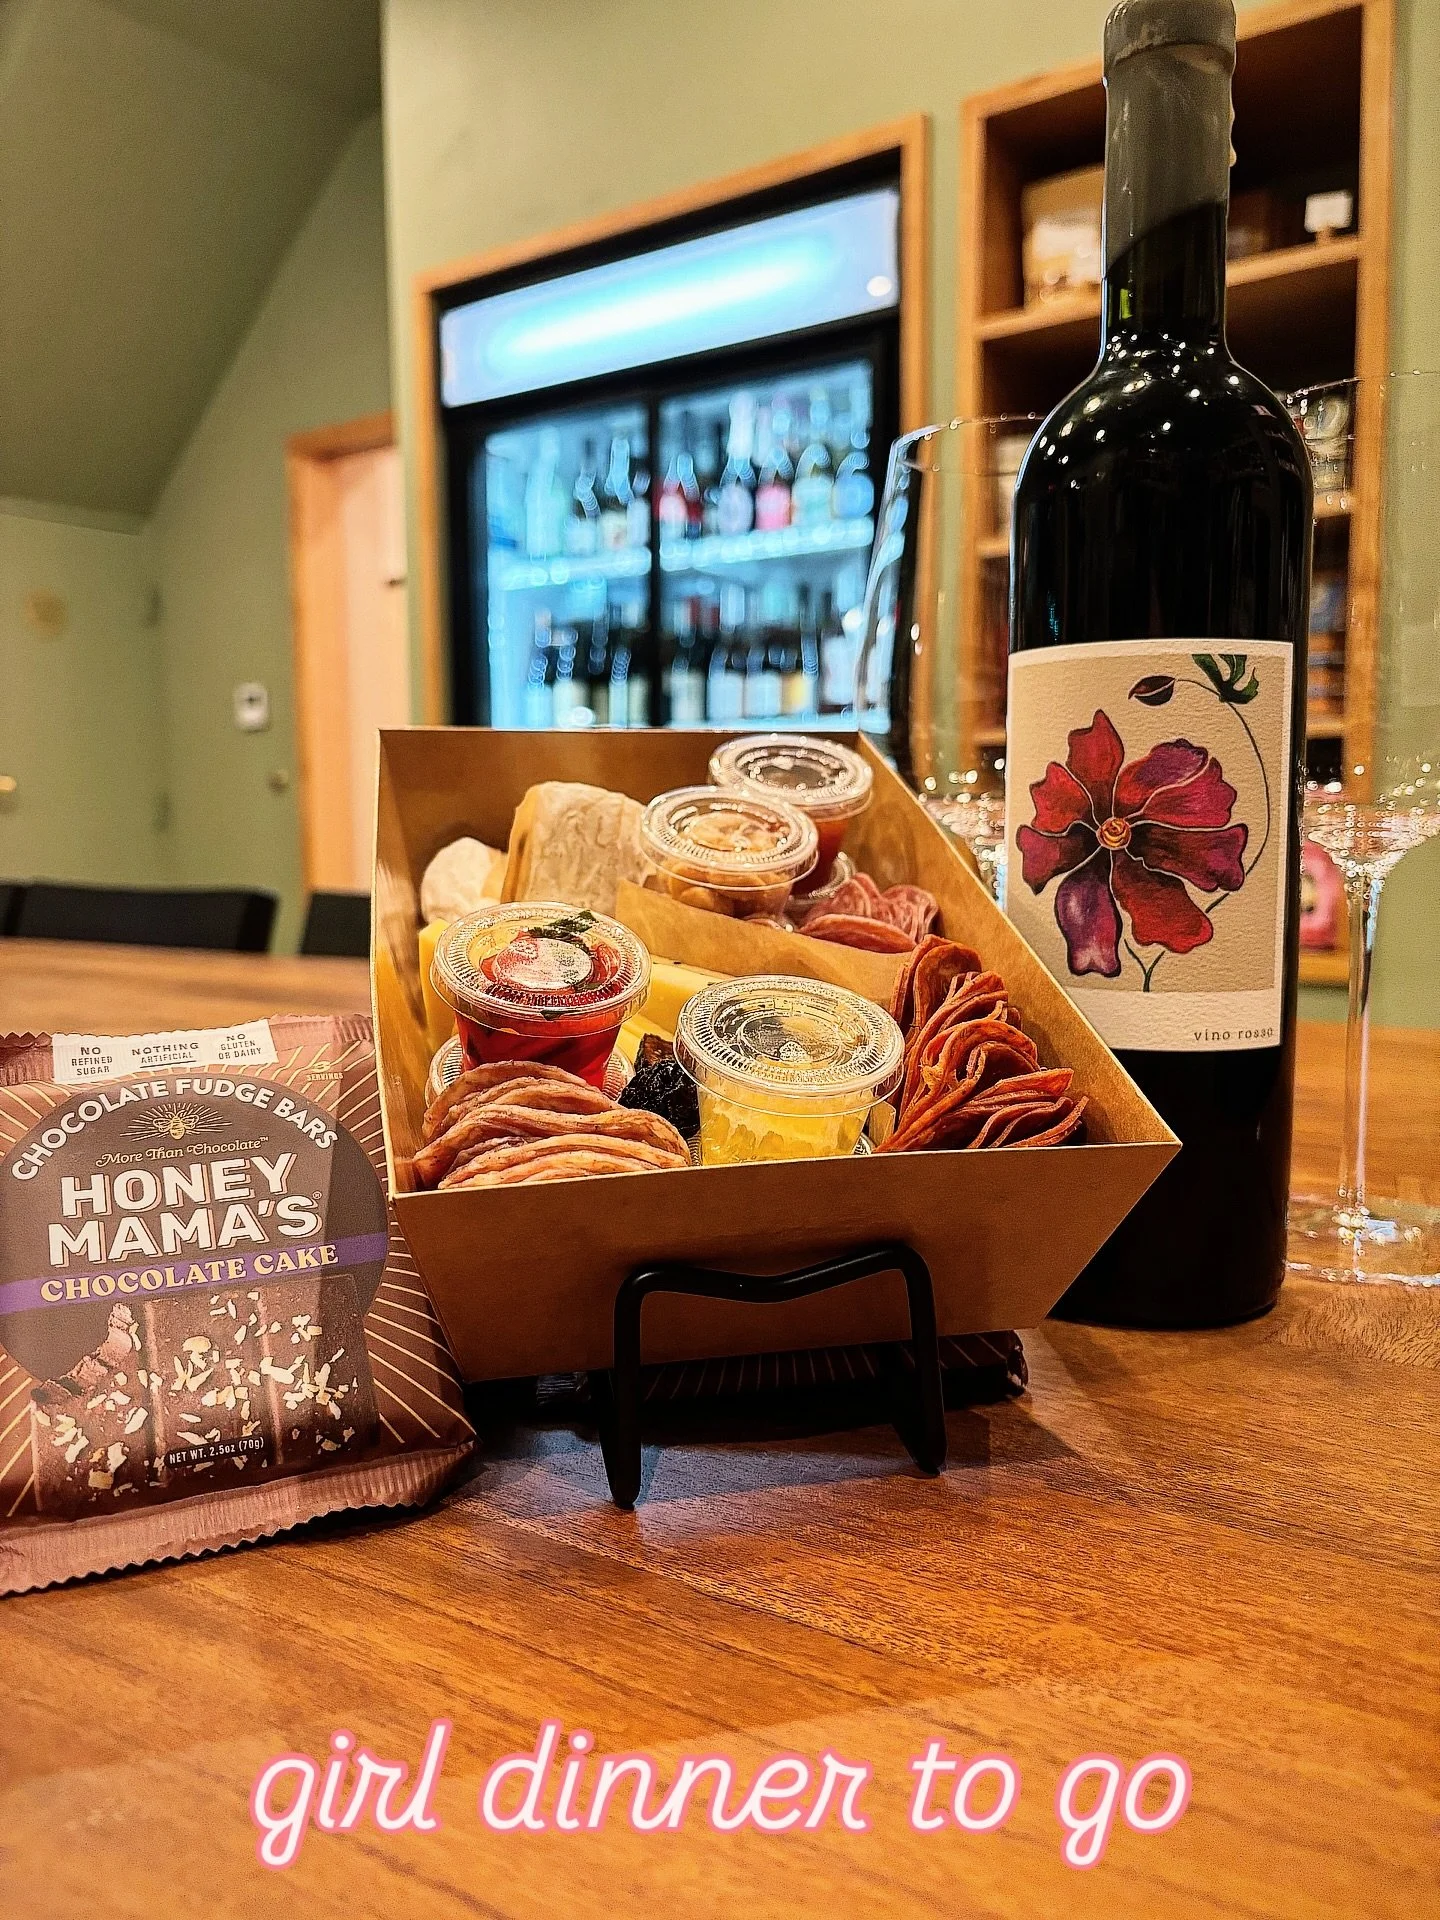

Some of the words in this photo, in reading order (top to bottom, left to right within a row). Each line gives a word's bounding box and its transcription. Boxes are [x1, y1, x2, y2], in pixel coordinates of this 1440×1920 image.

[226, 1033, 246, 1042] NO
[1194, 1028, 1231, 1041] vino
[1238, 1027, 1274, 1039] rosso
[80, 1046, 102, 1055] NO
[131, 1042, 199, 1057] NOTHING
[220, 1039, 256, 1049] GLUTEN
[141, 1051, 193, 1064] ARTIFICIAL
[218, 1049, 234, 1060] OR
[235, 1045, 262, 1058] DAIRY
[71, 1055, 113, 1066] REFINED
[76, 1065, 110, 1076] SUGAR
[306, 1071, 344, 1081] SERVINGS
[11, 1079, 168, 1181] CHOCOLATE
[175, 1078, 274, 1108] FUDGE
[272, 1097, 339, 1150] BARS
[95, 1148, 144, 1168] More
[145, 1145, 183, 1162] Than
[61, 1152, 298, 1218] HONEY
[40, 1256, 246, 1303] CHOCOLATE
[253, 1244, 339, 1275] CAKE
[169, 1451, 186, 1464] NET
[189, 1448, 207, 1461] WT.
[208, 1443, 236, 1457] 2.5oz
[238, 1437, 264, 1451] (70g)
